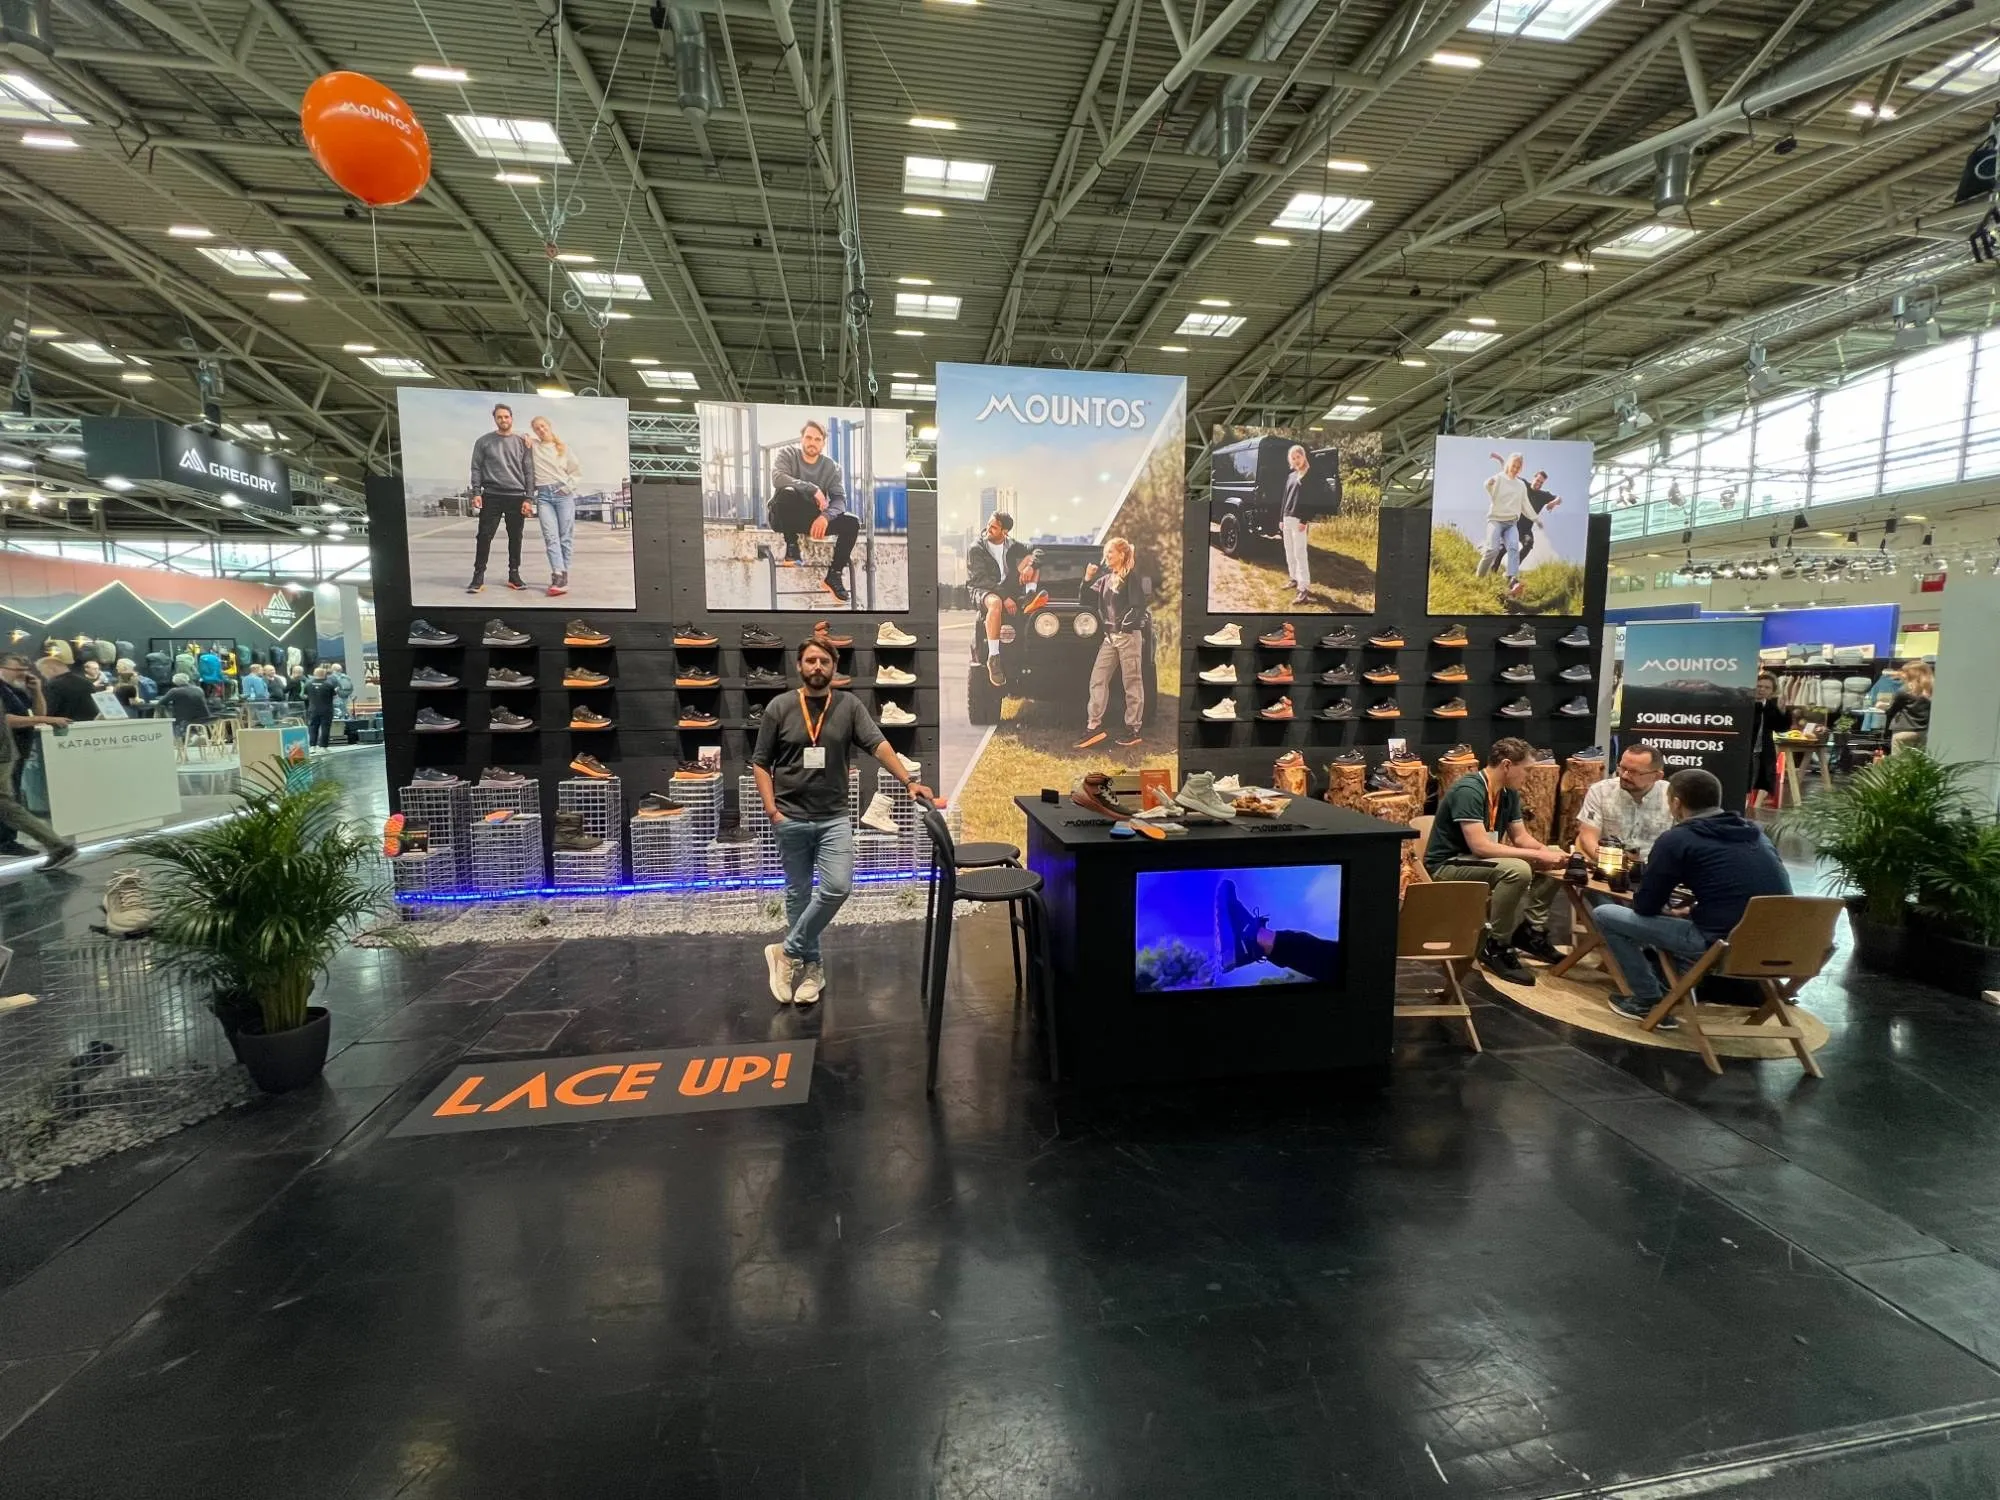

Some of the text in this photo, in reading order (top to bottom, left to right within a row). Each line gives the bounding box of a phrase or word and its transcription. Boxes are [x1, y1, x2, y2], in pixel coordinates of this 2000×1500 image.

[339, 101, 411, 135] MOUNTOS
[975, 393, 1146, 429] MOUNTOS
[1637, 657, 1738, 672] MOUNTOS
[1636, 712, 1734, 726] SOURCING FOR
[58, 735, 117, 749] KATADYN
[122, 732, 162, 744] GROUP
[1641, 737, 1724, 752] DISTRIBUTORS
[432, 1053, 792, 1117] LACE UP!
